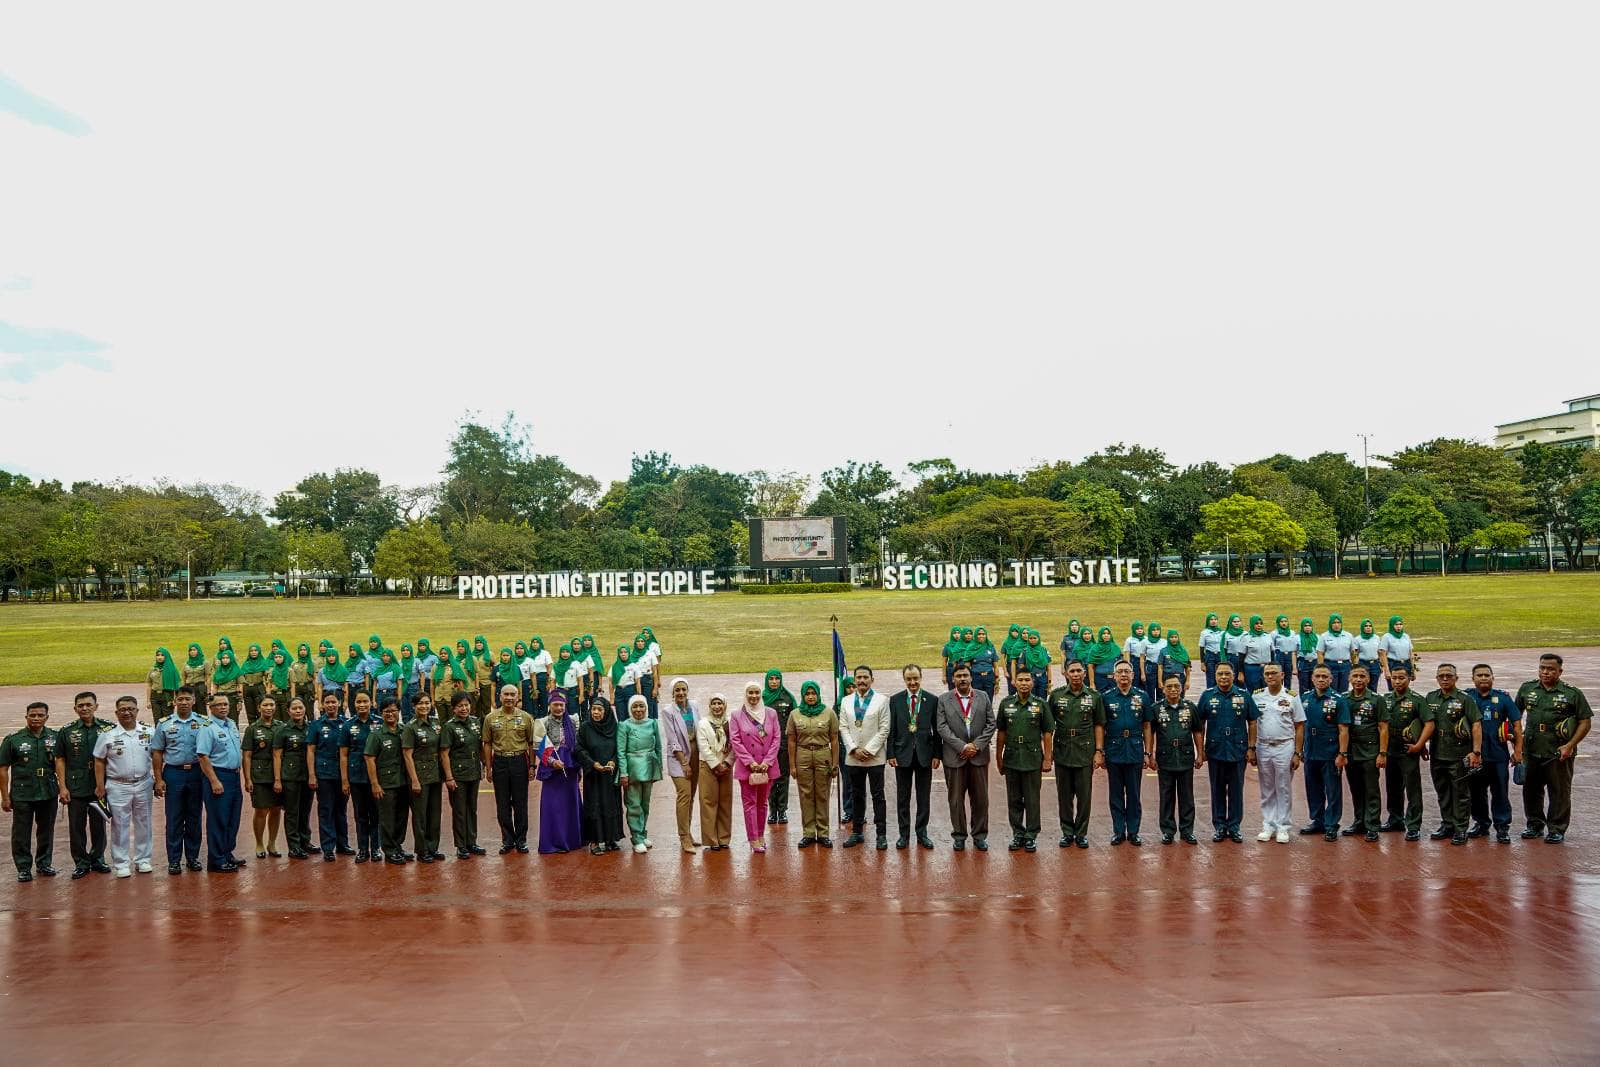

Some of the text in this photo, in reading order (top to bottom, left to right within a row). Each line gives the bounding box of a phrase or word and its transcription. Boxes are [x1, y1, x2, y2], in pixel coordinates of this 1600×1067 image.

[458, 570, 715, 599] PROTECTING THE PEOPLE
[884, 559, 1140, 590] SECURING THE STATE
